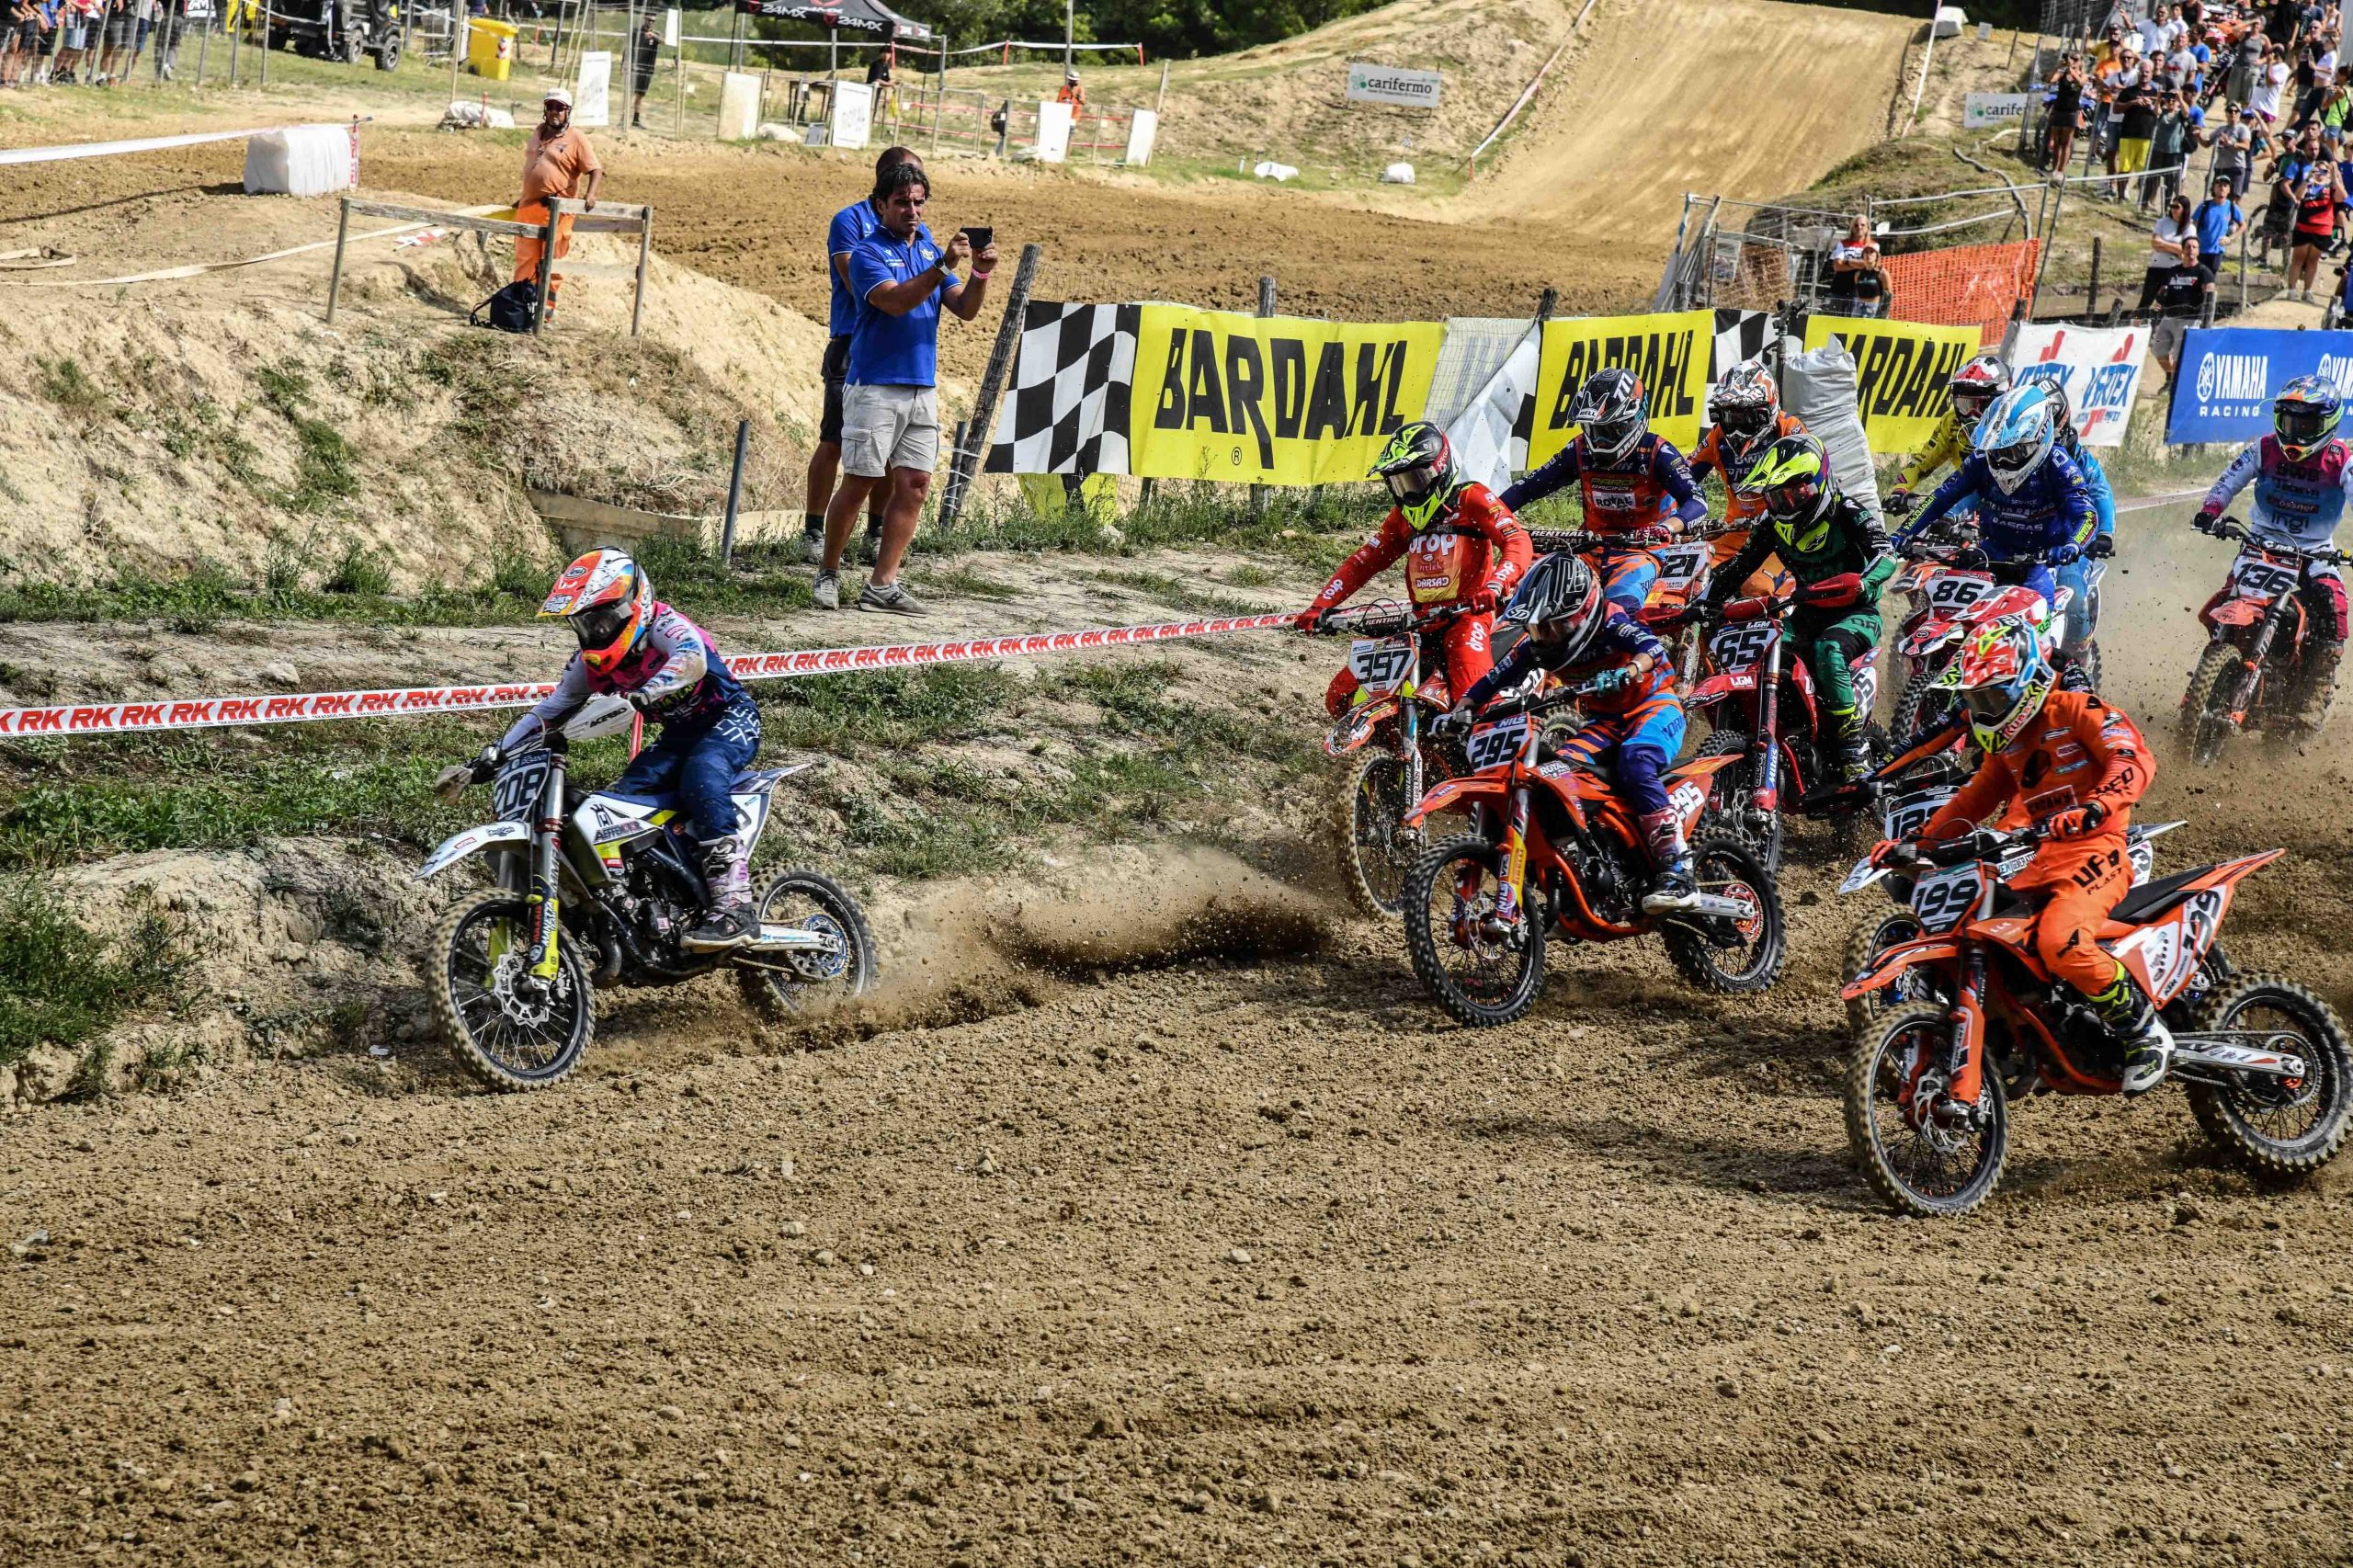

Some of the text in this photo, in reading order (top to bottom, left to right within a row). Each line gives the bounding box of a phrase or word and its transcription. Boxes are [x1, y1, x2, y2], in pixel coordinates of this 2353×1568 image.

[762, 4, 807, 18] 24MX
[837, 16, 882, 31] 24MX
[1368, 77, 1433, 95] carifermo
[1985, 103, 2024, 116] carife
[1614, 371, 1634, 403] 777
[1836, 333, 1967, 434] RDAH
[2080, 362, 2139, 410] VERTEX
[2214, 355, 2268, 399] YAMAHA
[1154, 327, 1408, 470] BARDAHL
[2200, 405, 2260, 417] RACING
[1998, 435, 2020, 448] AIROH
[1595, 495, 1633, 507] ROYAL
[1660, 553, 1700, 578] 21
[2236, 562, 2298, 596] 136
[1933, 580, 1985, 605] 86
[1465, 621, 1487, 652] drop
[1745, 620, 1771, 630] LGM
[732, 657, 763, 674] RK
[763, 654, 793, 672] RK
[794, 653, 824, 671] RK
[824, 651, 854, 669] RK
[855, 649, 883, 665] RK
[884, 647, 913, 665] RK
[914, 644, 942, 662] RK
[942, 642, 971, 660] RK
[971, 641, 999, 657] RK
[999, 638, 1025, 653] RK
[1027, 635, 1052, 651] RK
[1053, 633, 1080, 649] RK
[1080, 631, 1106, 646] RK
[1107, 629, 1133, 643] RK
[1133, 627, 1159, 642] RK
[1159, 624, 1185, 638] RK
[1716, 630, 1770, 668] 65
[1356, 650, 1413, 684] 397
[1730, 676, 1754, 687] LGM
[17, 710, 66, 732] RK
[69, 707, 118, 730] RK
[119, 705, 166, 726] RK
[169, 702, 215, 723] RK
[217, 699, 263, 720] RK
[265, 698, 310, 717] RK
[311, 695, 356, 714] RK
[357, 692, 401, 712] RK
[402, 690, 445, 708] RK
[445, 688, 488, 706] RK
[488, 687, 531, 701] RK
[1499, 715, 1527, 727] NILS
[1472, 729, 1528, 767] 295
[1891, 805, 1939, 841] 12
[2086, 867, 2123, 895] PLAST
[1915, 878, 1980, 920] 199
[540, 901, 555, 948] MANETTA
